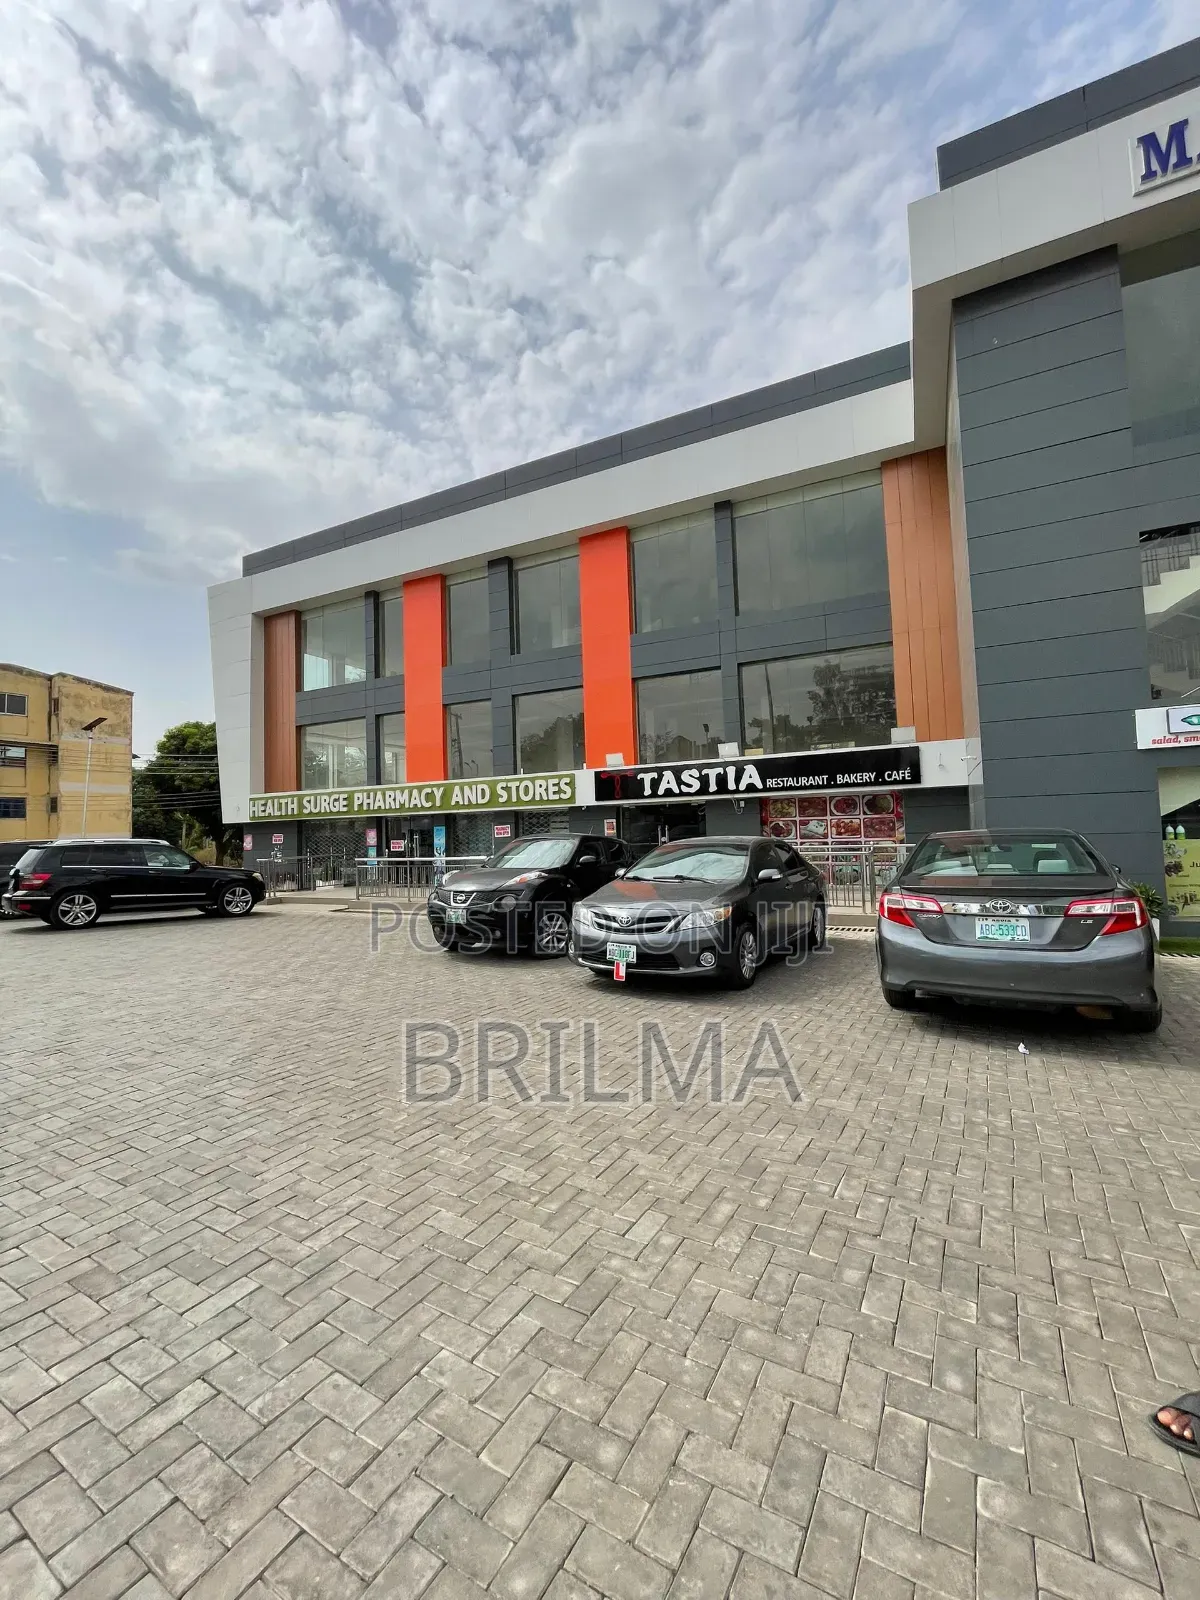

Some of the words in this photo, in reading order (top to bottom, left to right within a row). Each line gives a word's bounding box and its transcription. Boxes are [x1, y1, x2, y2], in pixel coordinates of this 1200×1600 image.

[1151, 735, 1181, 745] salad,
[637, 764, 764, 797] TASTIA
[766, 775, 829, 788] RESTAURANT
[836, 772, 876, 785] BAKERY
[884, 767, 912, 782] CAFÉ
[249, 797, 298, 818] HEALTH
[302, 793, 348, 814] SURGE
[353, 786, 445, 812] PHARMACY
[450, 783, 491, 806] AND
[496, 777, 572, 803] STORES
[615, 961, 625, 980] L
